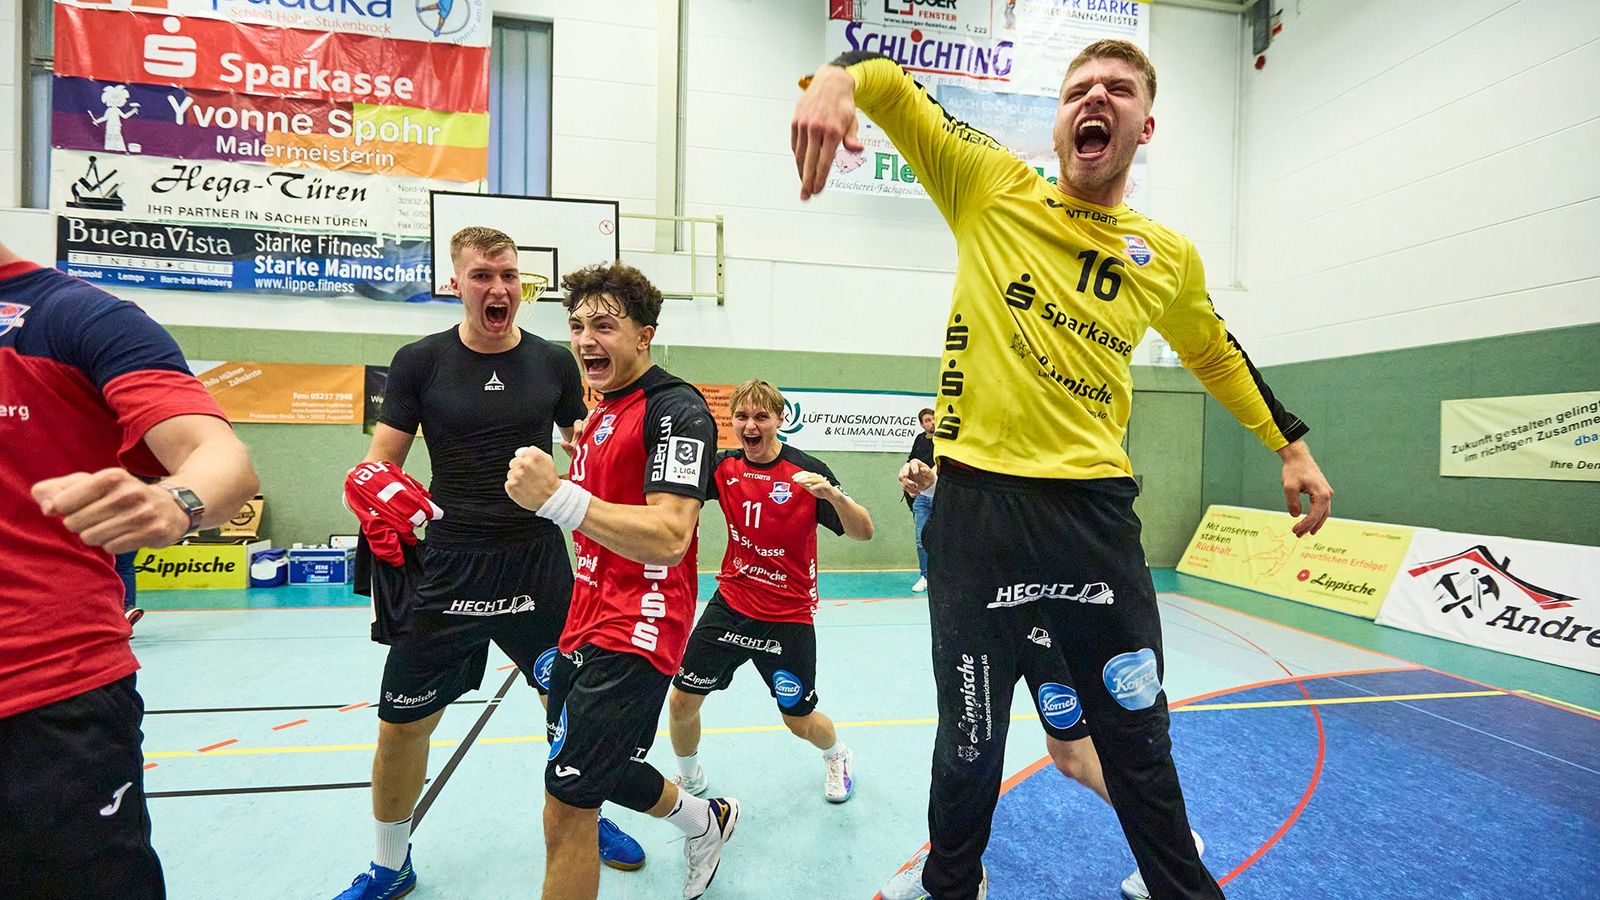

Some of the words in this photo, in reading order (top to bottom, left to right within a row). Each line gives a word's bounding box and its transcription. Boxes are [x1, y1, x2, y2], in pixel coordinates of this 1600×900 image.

[919, 10, 957, 21] FENSTER
[1087, 0, 1139, 16] BARKE
[219, 53, 414, 99] Sparkasse
[167, 95, 314, 136] Yvonne
[327, 107, 442, 146] Spohr
[215, 136, 395, 167] Malermeisterin
[151, 164, 367, 202] Hega-Türen
[148, 205, 172, 216] IHR
[178, 206, 239, 219] PARTNER
[245, 211, 258, 221] IN
[264, 212, 320, 225] SACHEN
[326, 215, 368, 228] TÜREN
[67, 217, 233, 255] BuenaVista
[254, 232, 312, 253] Starke
[318, 236, 384, 260] Fitness.
[71, 254, 164, 271] FITNESS
[177, 261, 232, 274] CLUB
[254, 254, 319, 277] Starke
[324, 258, 431, 284] Mannschaft
[68, 269, 102, 279] Detmold
[117, 273, 145, 283] Lemgo
[160, 276, 196, 286] Horn-Bad
[197, 279, 233, 289] Meinberg
[254, 276, 355, 293] www.lippe.fitness
[1076, 249, 1125, 302] 16
[1041, 302, 1132, 356] Sparkasse
[802, 411, 917, 426] LÜFTUNGSMONTAGE
[824, 427, 832, 436] &
[834, 427, 916, 437] KLIMAANLAGEN
[1451, 434, 1493, 454] Zukunft
[1495, 415, 1552, 443] gestalten
[1464, 452, 1478, 463] im
[1481, 437, 1533, 459] richtigen
[1550, 460, 1573, 469] Ihre
[742, 500, 762, 529] 11
[1200, 533, 1232, 544] starken
[1205, 522, 1219, 531] Mit
[1220, 526, 1259, 538] unserem
[1300, 552, 1348, 565] sportlichen
[1313, 543, 1325, 551] für
[1326, 546, 1347, 554] eure
[134, 554, 236, 577] Lippische
[996, 583, 1075, 602] HECHT
[1310, 573, 1377, 596] Lippische
[449, 599, 508, 613] HECHT
[724, 631, 764, 647] HECHT
[393, 689, 437, 705] Lippische
[957, 653, 980, 744] Lippische
[1043, 694, 1077, 714] Komet
